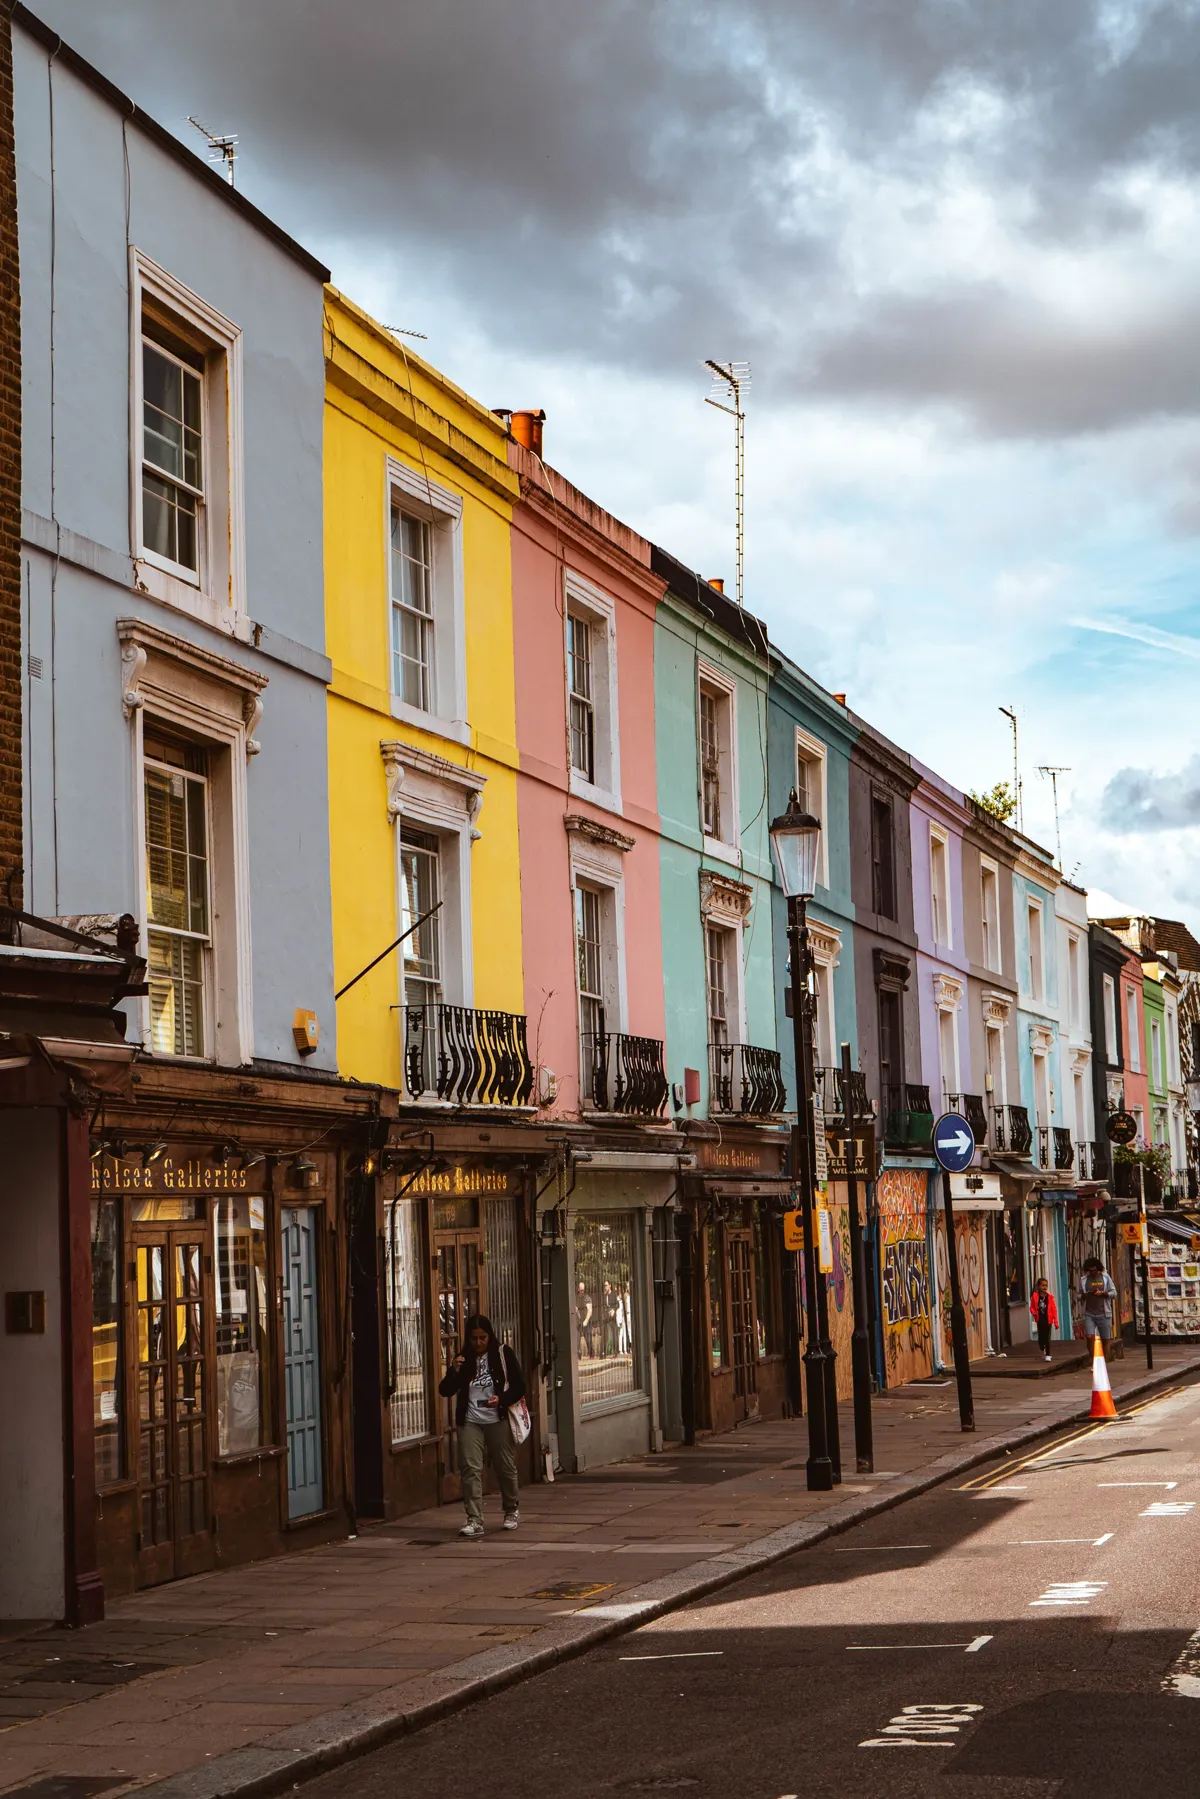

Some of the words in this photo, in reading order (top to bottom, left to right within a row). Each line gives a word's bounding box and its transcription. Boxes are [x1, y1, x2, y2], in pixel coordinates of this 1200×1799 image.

[91, 1158, 153, 1189] helsea
[163, 1158, 247, 1189] Galleries
[857, 1704, 984, 1747] P003
